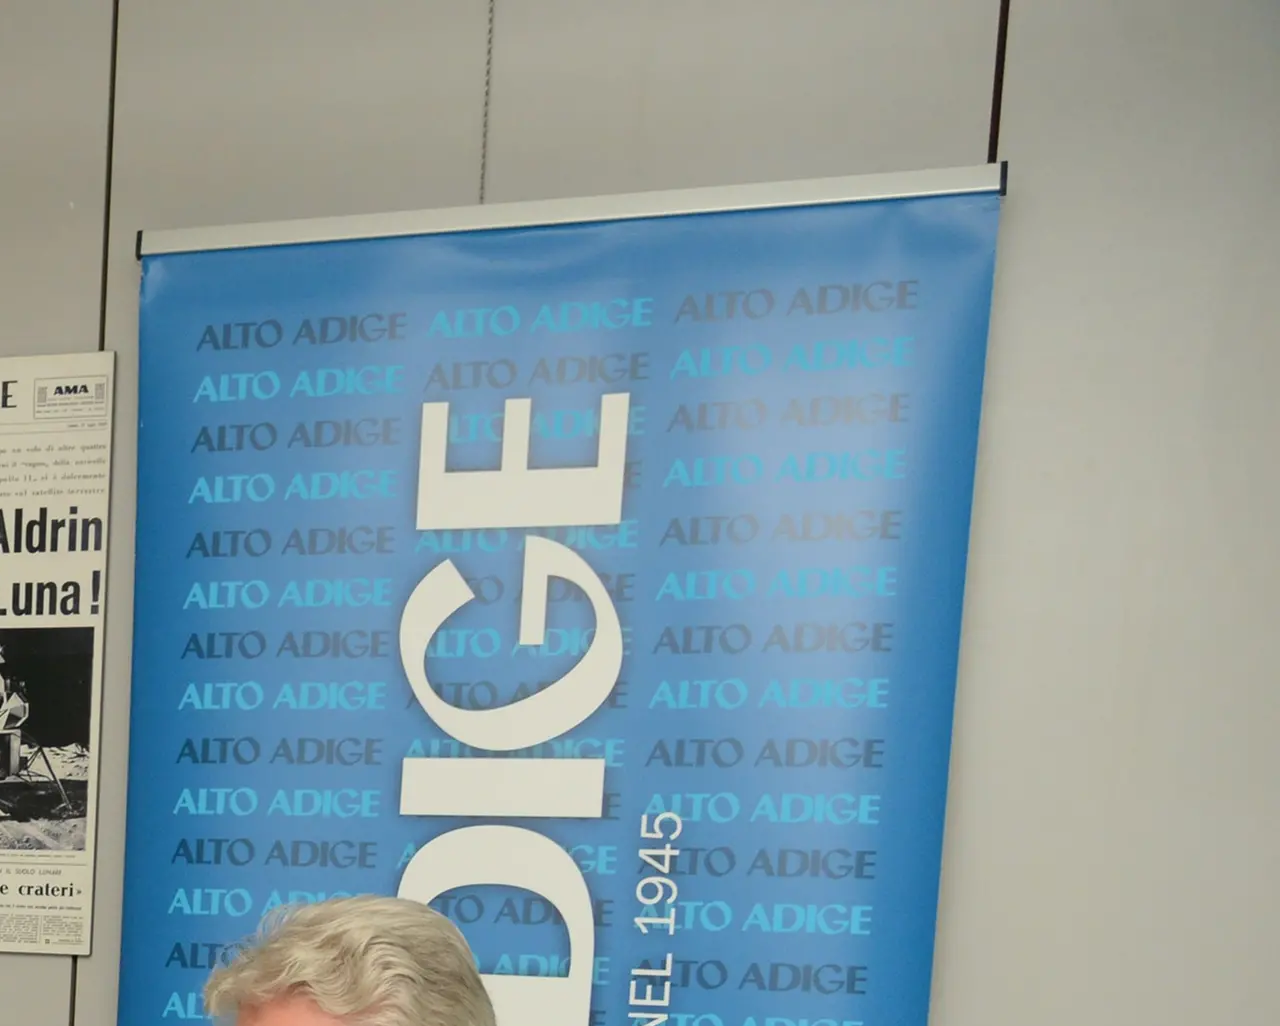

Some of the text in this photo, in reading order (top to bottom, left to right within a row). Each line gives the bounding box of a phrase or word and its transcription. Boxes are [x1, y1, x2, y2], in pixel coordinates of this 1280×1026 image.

[426, 297, 654, 339] ALTO ADIGE
[675, 280, 919, 325] ALTO ADIGE
[196, 312, 407, 351] ALTO ADIGE
[424, 352, 650, 392] ALTO ADIGE
[670, 336, 915, 380] ALTO ADIGE
[53, 384, 89, 396] AMA
[193, 365, 406, 403] ALTO ADIGE
[191, 417, 401, 453] ALTO ADIGE
[662, 449, 907, 488] ALTO ADIGE
[188, 470, 398, 503] ALTO ADIGE
[186, 526, 396, 558] ALTO ADIGE
[771, 510, 903, 542] ADIGE
[183, 578, 392, 610] ALTO ADIGE
[655, 566, 898, 602] ALTO ADIGE
[181, 630, 390, 659] ALTO ADIGE
[652, 622, 895, 655] ALTO ADIGE
[179, 681, 386, 711] ALTO ADIGE
[648, 678, 889, 710] ALTO ADIGE
[176, 737, 383, 766] ALTO ADIGE
[644, 737, 885, 769] ALTO ADIGE
[173, 787, 381, 819] ALTO ADIGE
[750, 793, 881, 825] ADIGE
[171, 838, 377, 869] ALTO ADIGE
[747, 848, 878, 880] ADIGE
[0, 883, 9, 895] e
[634, 812, 682, 935] 1945
[168, 888, 251, 916] ALTO
[742, 904, 873, 935] ADIGE
[738, 962, 868, 995] ADIGE
